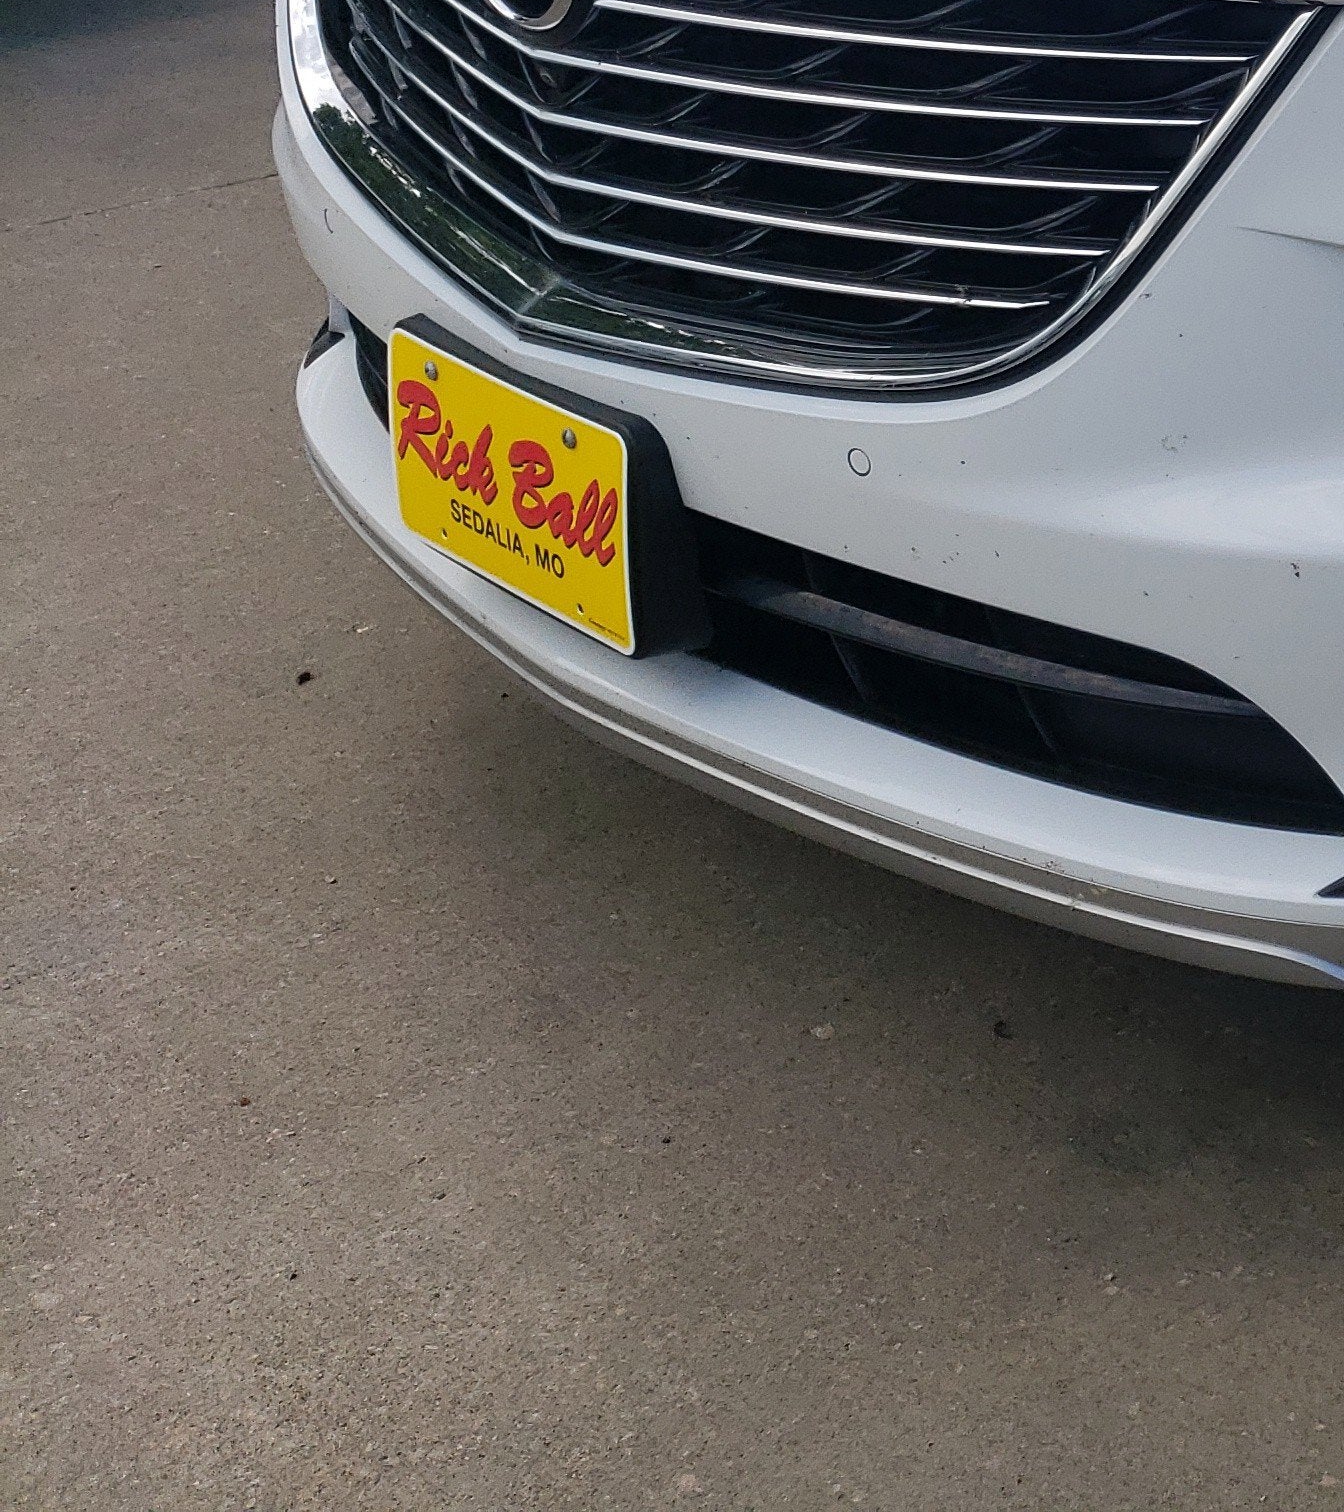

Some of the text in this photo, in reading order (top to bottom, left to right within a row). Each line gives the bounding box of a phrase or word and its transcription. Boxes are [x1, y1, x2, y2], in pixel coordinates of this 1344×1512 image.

[397, 379, 619, 568] Rick Ball
[450, 497, 565, 579] SEDALIA, MO
